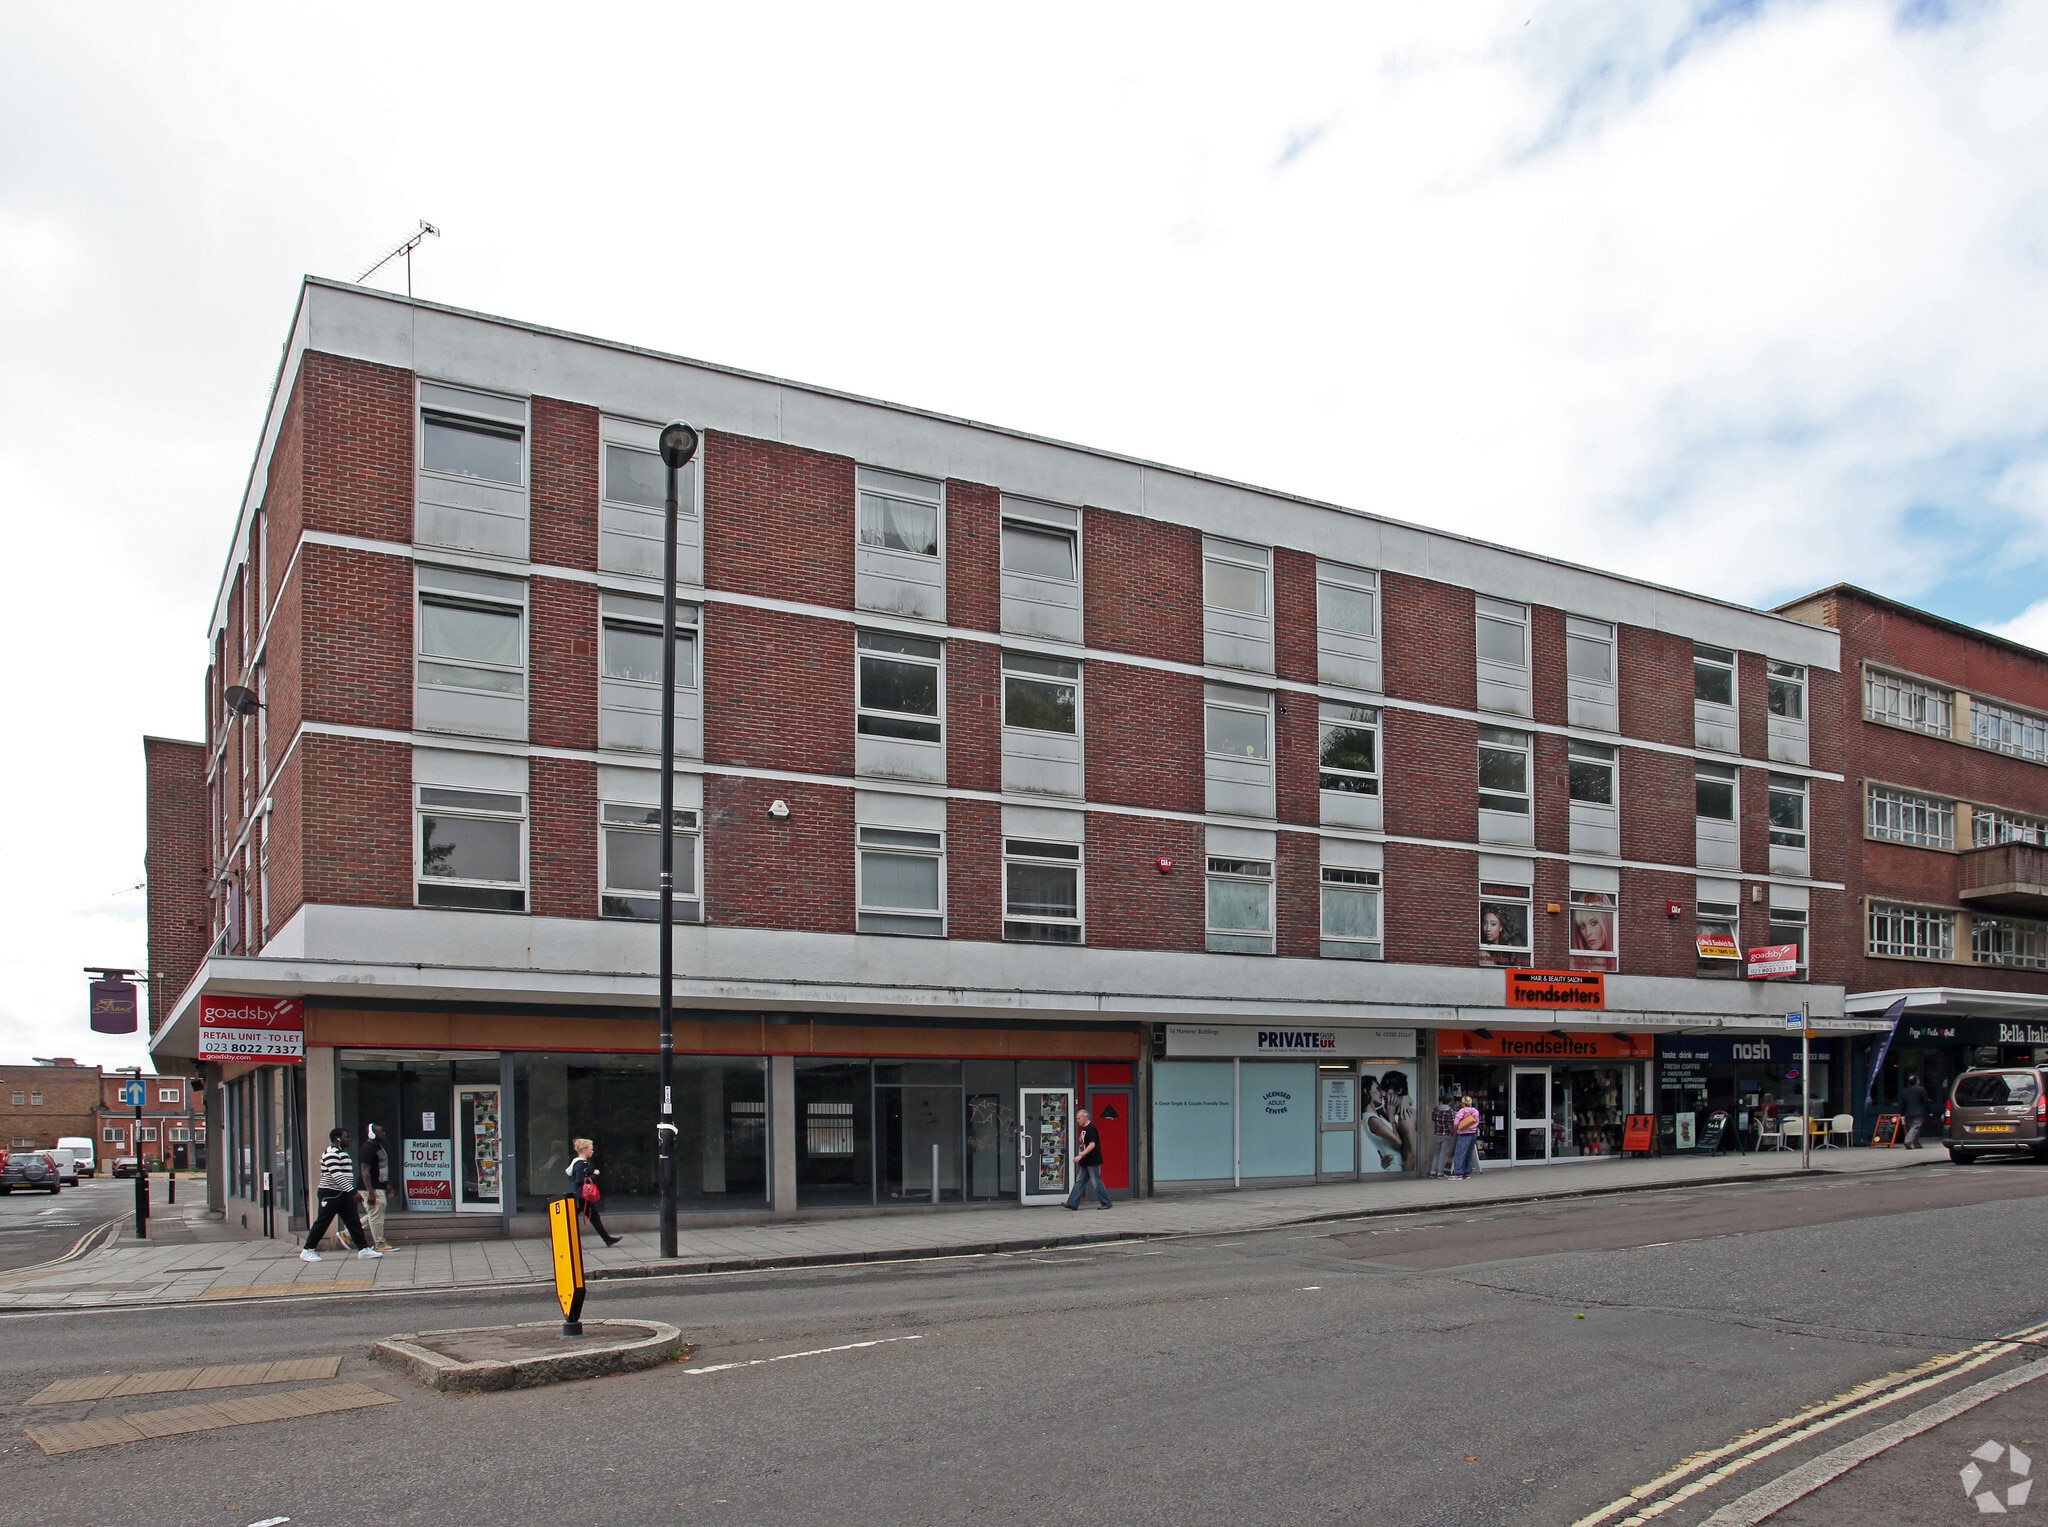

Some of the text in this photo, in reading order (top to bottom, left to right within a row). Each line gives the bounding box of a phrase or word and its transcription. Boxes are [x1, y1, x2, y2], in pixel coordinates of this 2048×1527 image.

[1751, 951, 1782, 962] goadsby
[1515, 984, 1600, 1004] trendsetters
[204, 1005, 278, 1026] goadsby
[203, 1032, 236, 1040] RETAIL
[239, 1033, 261, 1041] UNIT
[269, 1034, 281, 1042] TO
[1999, 1023, 2025, 1043] Bella
[1258, 1032, 1319, 1048] PRIVATE
[1320, 1040, 1336, 1048] UK
[1501, 1036, 1598, 1054] trendsetters
[206, 1042, 297, 1054] 023 8022 7337
[1733, 1039, 1770, 1059] nosh
[1662, 1051, 1676, 1059] taste
[1679, 1051, 1692, 1059] drink
[1263, 1091, 1291, 1100] LICENSED
[410, 1151, 445, 1161] TO LET
[409, 1186, 440, 1196] goadsby
